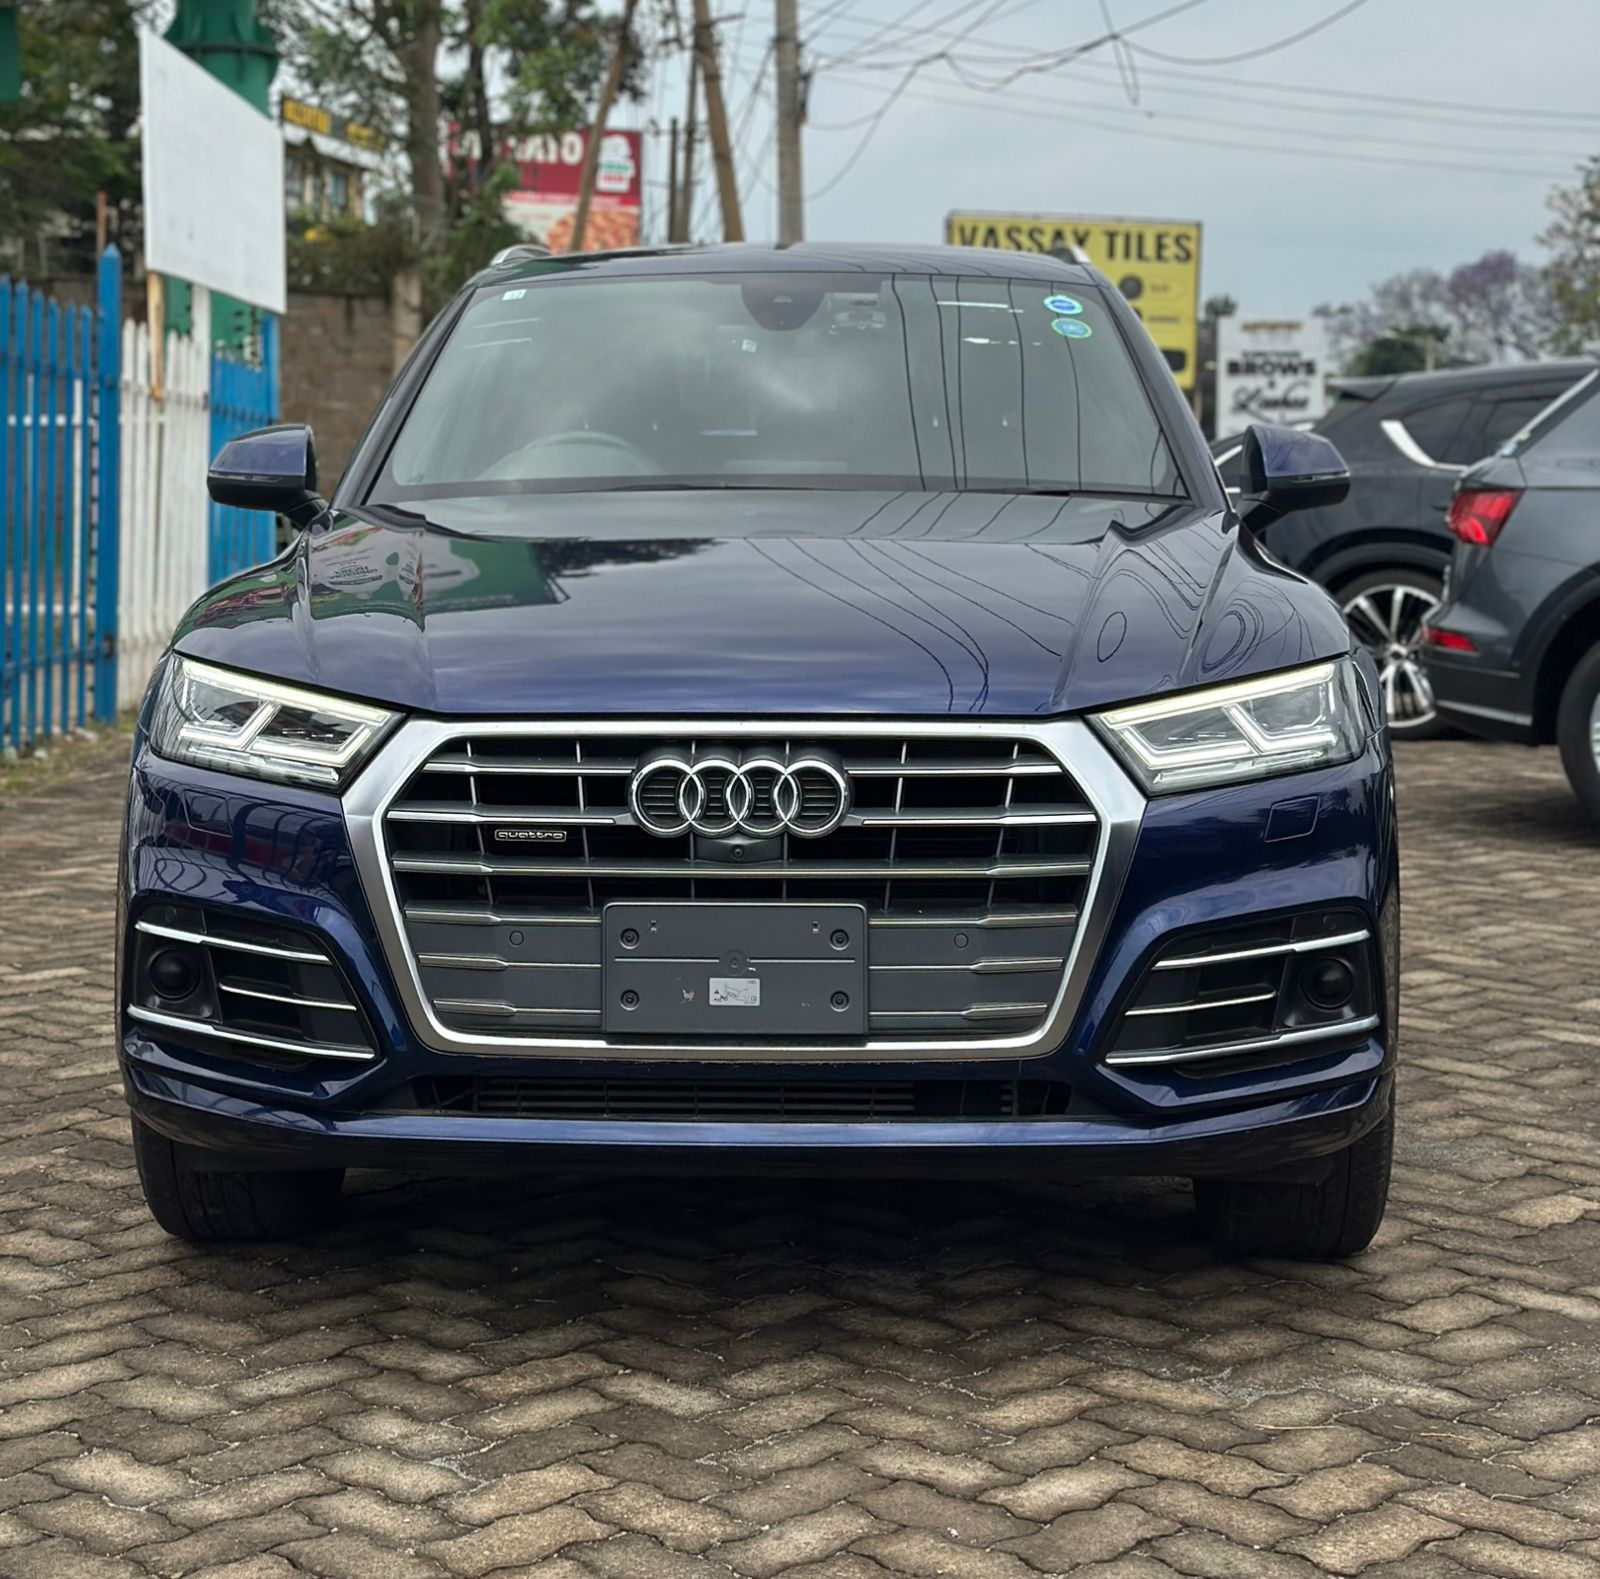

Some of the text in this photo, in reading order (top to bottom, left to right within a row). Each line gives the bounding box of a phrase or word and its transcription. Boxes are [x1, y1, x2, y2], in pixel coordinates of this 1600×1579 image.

[1104, 229, 1192, 263] TILES
[1228, 361, 1316, 376] BROWS
[498, 831, 563, 840] quattro
